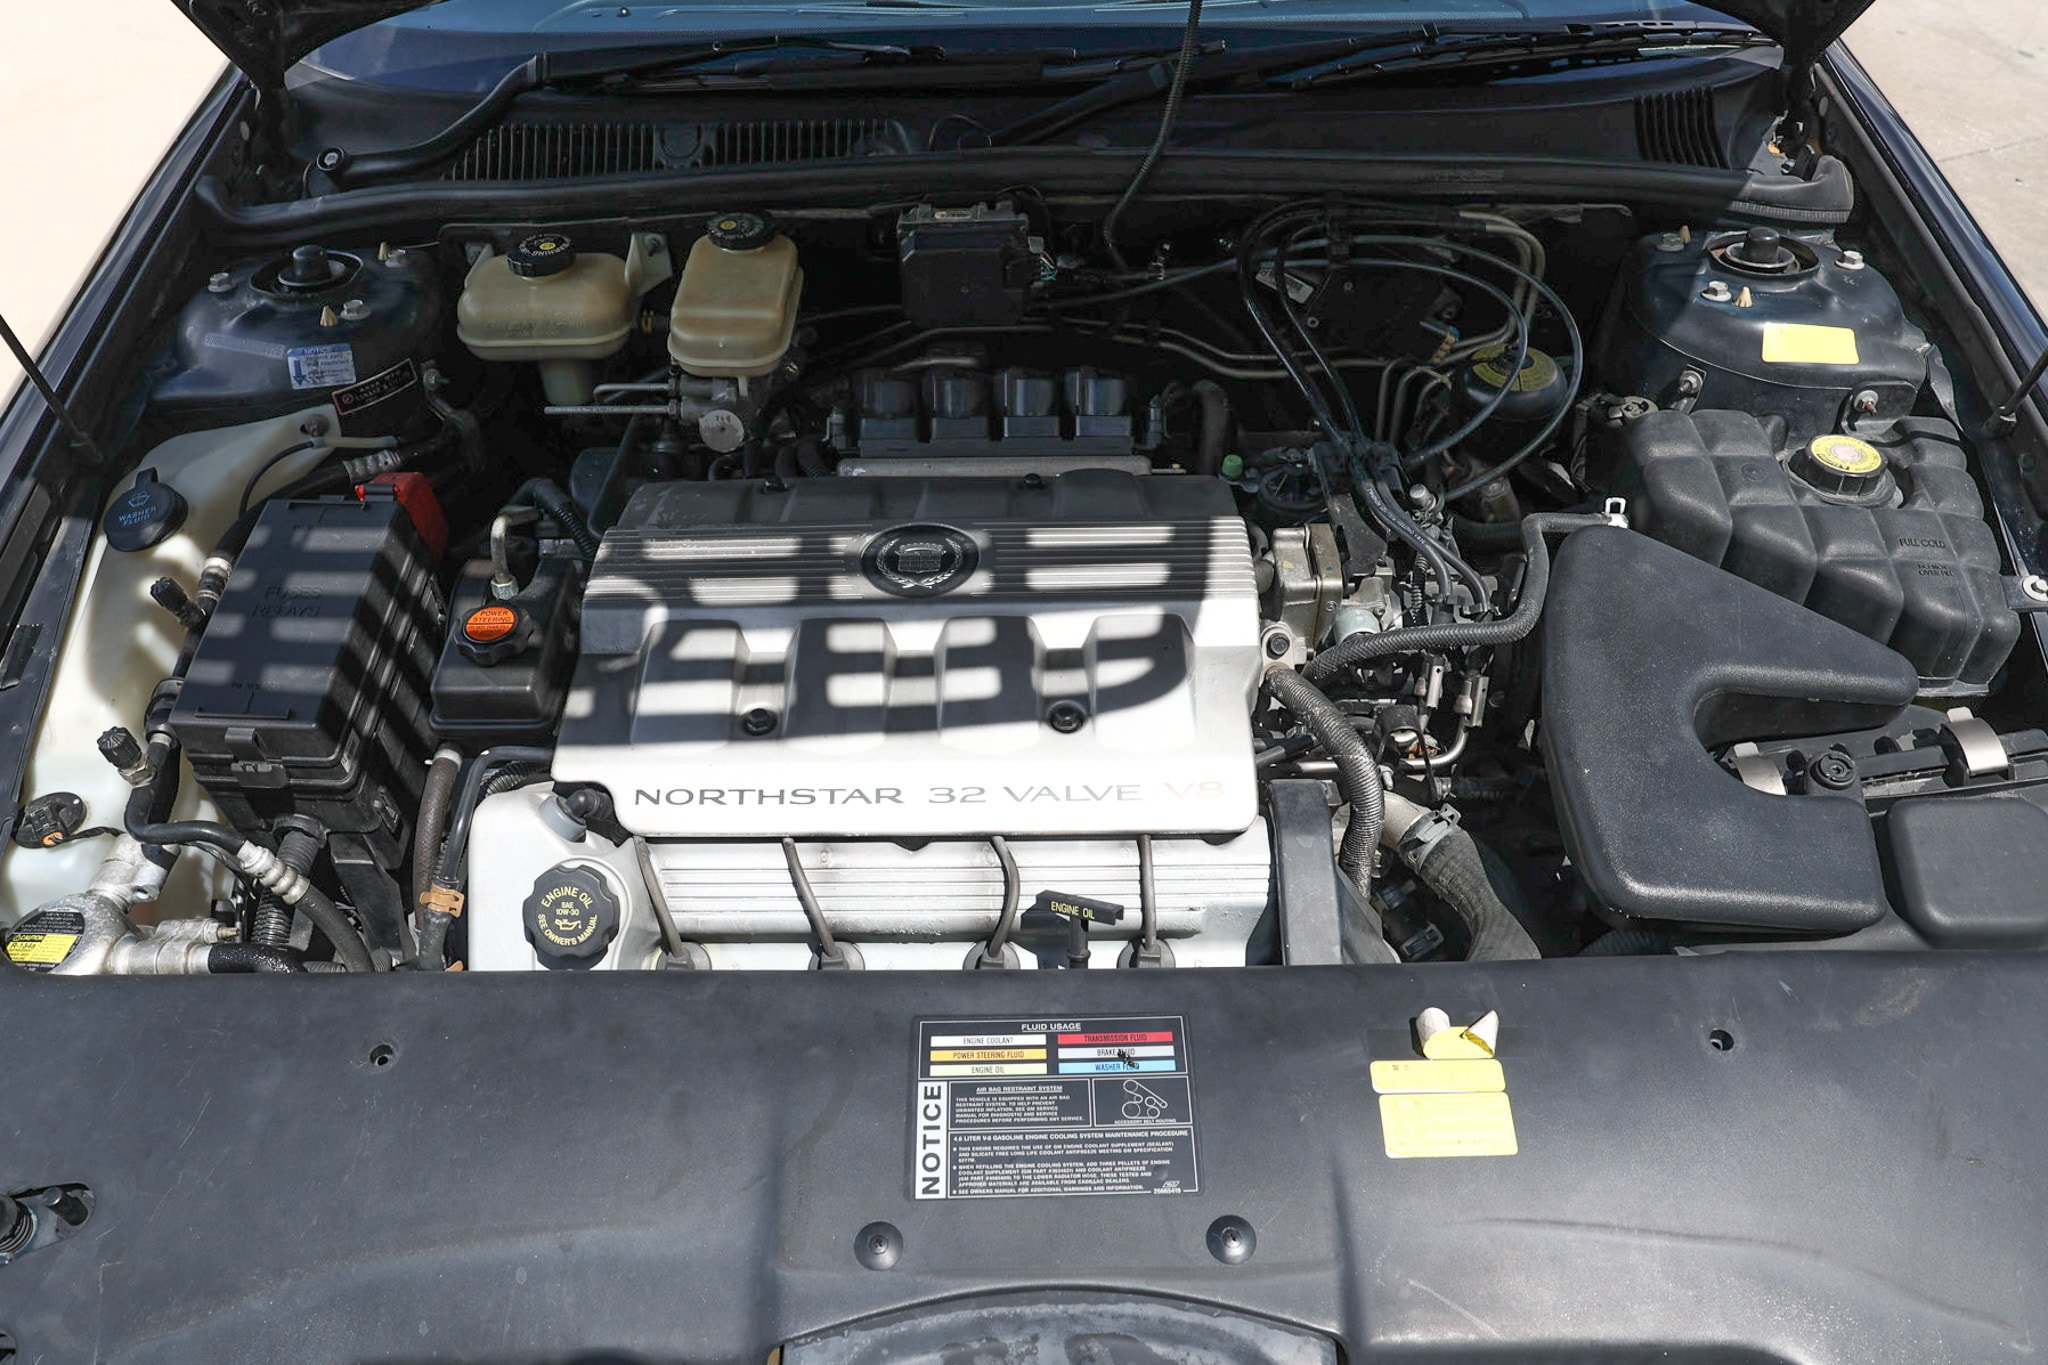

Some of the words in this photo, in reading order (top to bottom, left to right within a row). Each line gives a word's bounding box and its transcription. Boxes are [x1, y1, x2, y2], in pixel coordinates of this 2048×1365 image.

[119, 506, 158, 521] WASHER
[123, 513, 150, 527] FLUID
[1899, 538, 1919, 547] FULL
[1920, 539, 1946, 549] COLD
[252, 604, 320, 618] RELAYS
[473, 616, 511, 624] STEERING
[634, 787, 904, 805] NORTHSTAR
[928, 786, 986, 804] 32
[1002, 784, 1143, 802] VALVE
[1163, 781, 1225, 798] V8
[541, 886, 579, 908] ENGINE
[579, 892, 593, 909] OIL
[561, 901, 575, 909] SAE
[556, 908, 580, 916] 10W-30
[1050, 901, 1080, 916] ENGINE
[1082, 907, 1095, 919] OIL
[538, 913, 549, 930] SEE
[544, 928, 577, 946] OWNER'S
[577, 914, 598, 943] MANUAL
[1021, 1023, 1047, 1031] FLUID
[1049, 1022, 1081, 1030] USAGE
[963, 1037, 984, 1045] ENGINE
[986, 1036, 1013, 1045] COOLANT
[1084, 1034, 1128, 1042] TRANSMISSION
[1129, 1033, 1147, 1041] FLUID
[1006, 1050, 1024, 1058] FLUID
[1096, 1048, 1117, 1056] BRAKE
[971, 1065, 992, 1073] ENGINE
[994, 1065, 1004, 1073] OIL
[1095, 1063, 1120, 1071] WASHER
[922, 1085, 941, 1195] NOTICE
